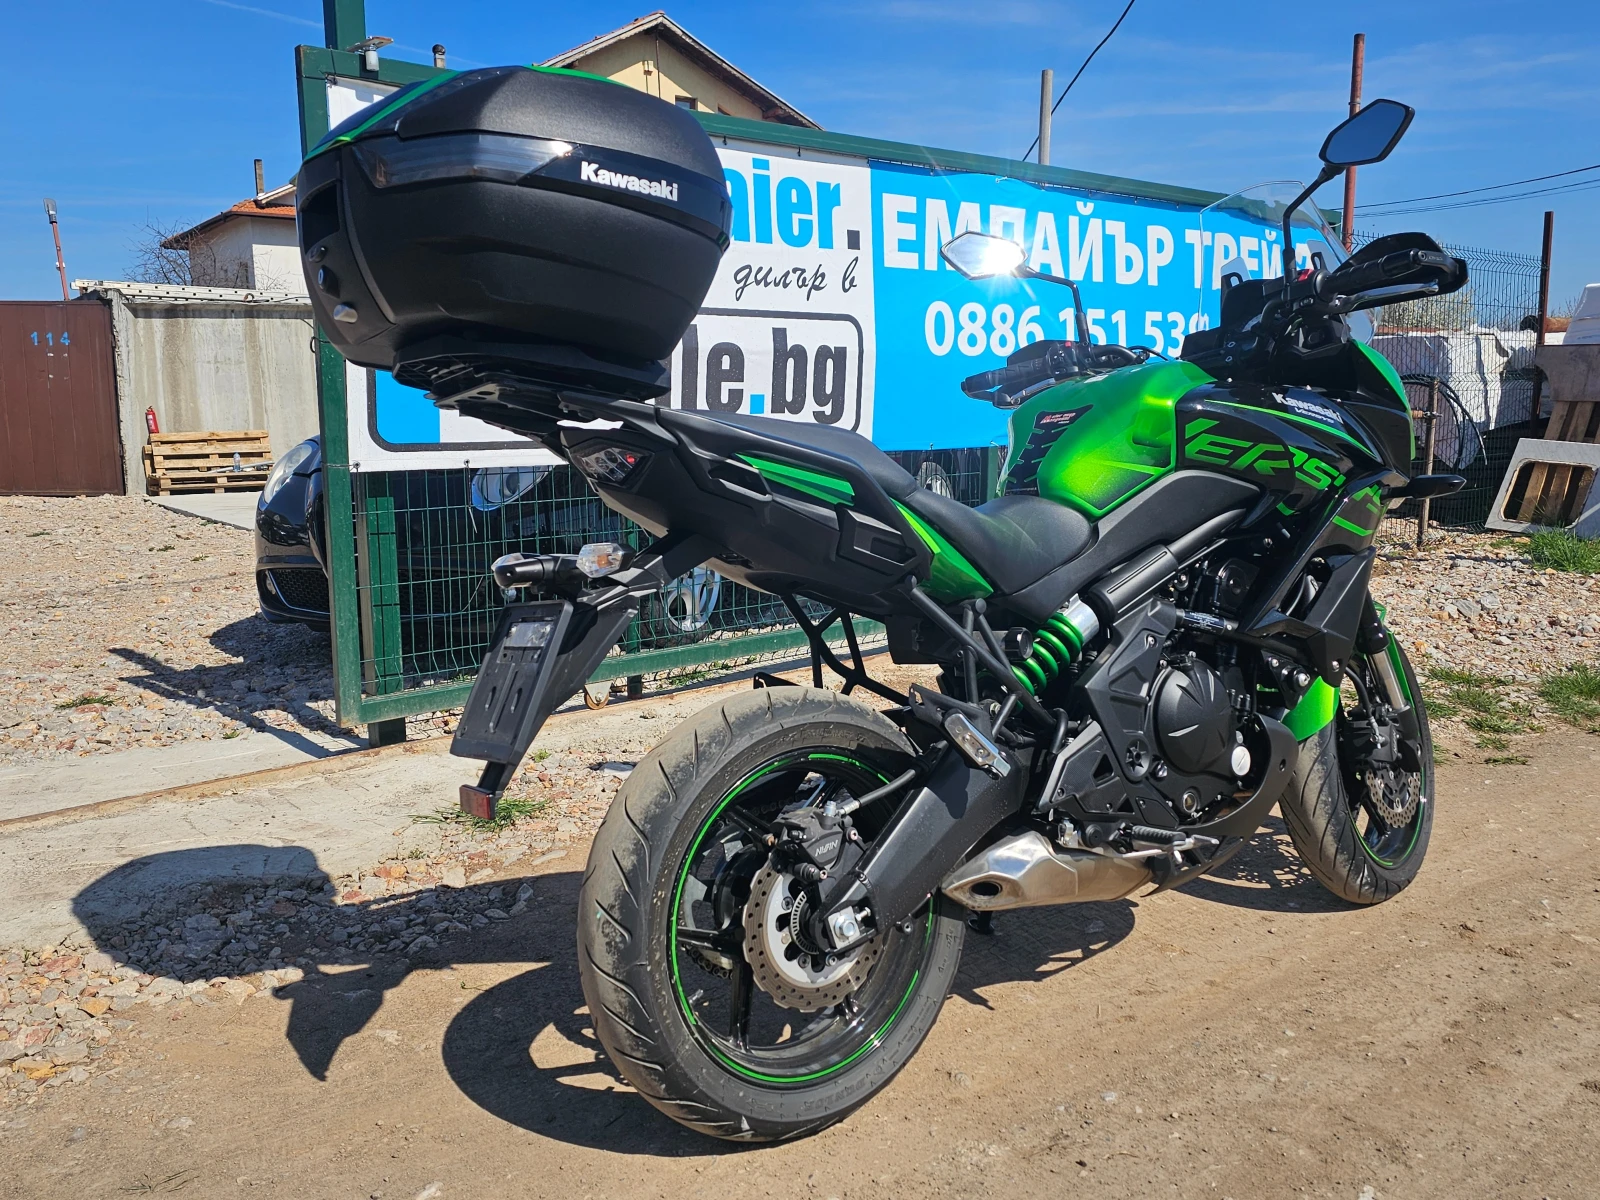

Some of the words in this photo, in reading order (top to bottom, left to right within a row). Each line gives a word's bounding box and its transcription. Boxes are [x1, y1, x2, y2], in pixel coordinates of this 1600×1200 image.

[580, 160, 679, 202] Kawasaki
[733, 263, 828, 302] дилър
[841, 256, 859, 294] в
[924, 300, 1046, 357] 0886
[1058, 307, 1128, 350] 151
[1271, 391, 1344, 424] Kawasaki
